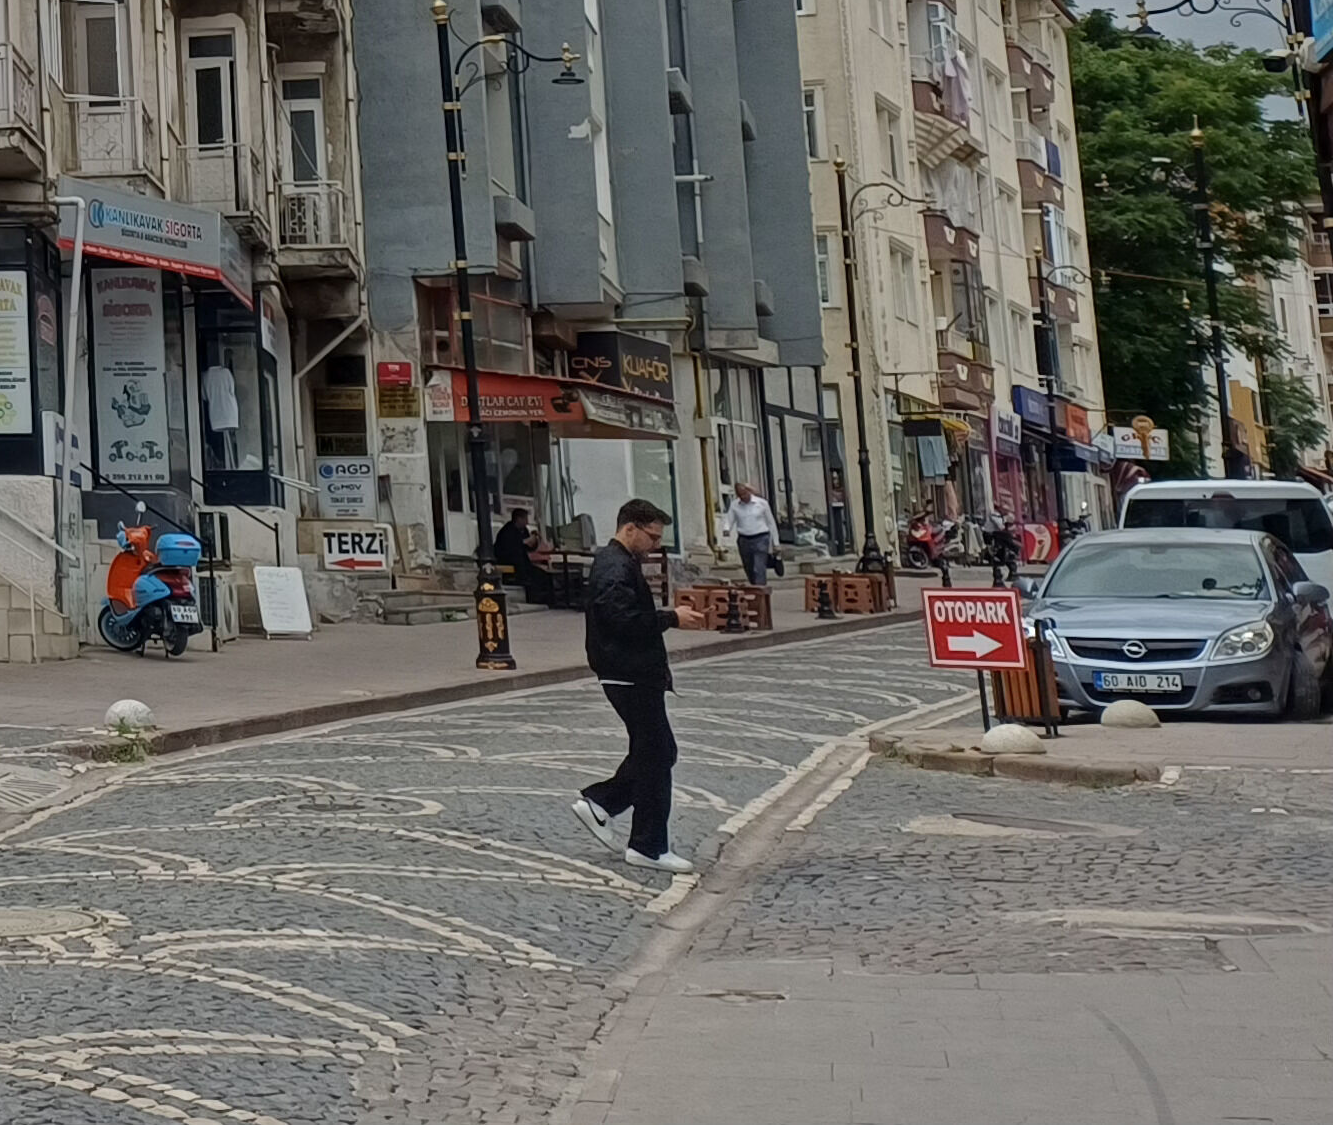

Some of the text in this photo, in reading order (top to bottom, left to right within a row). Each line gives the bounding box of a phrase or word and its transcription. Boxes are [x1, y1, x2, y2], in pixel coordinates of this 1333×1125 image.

[104, 207, 164, 233] KANLIKAVAK
[335, 464, 371, 475] AGD
[934, 600, 1011, 624] OTOPARK
[1103, 676, 1118, 687] 60
[1157, 676, 1179, 688] 214
